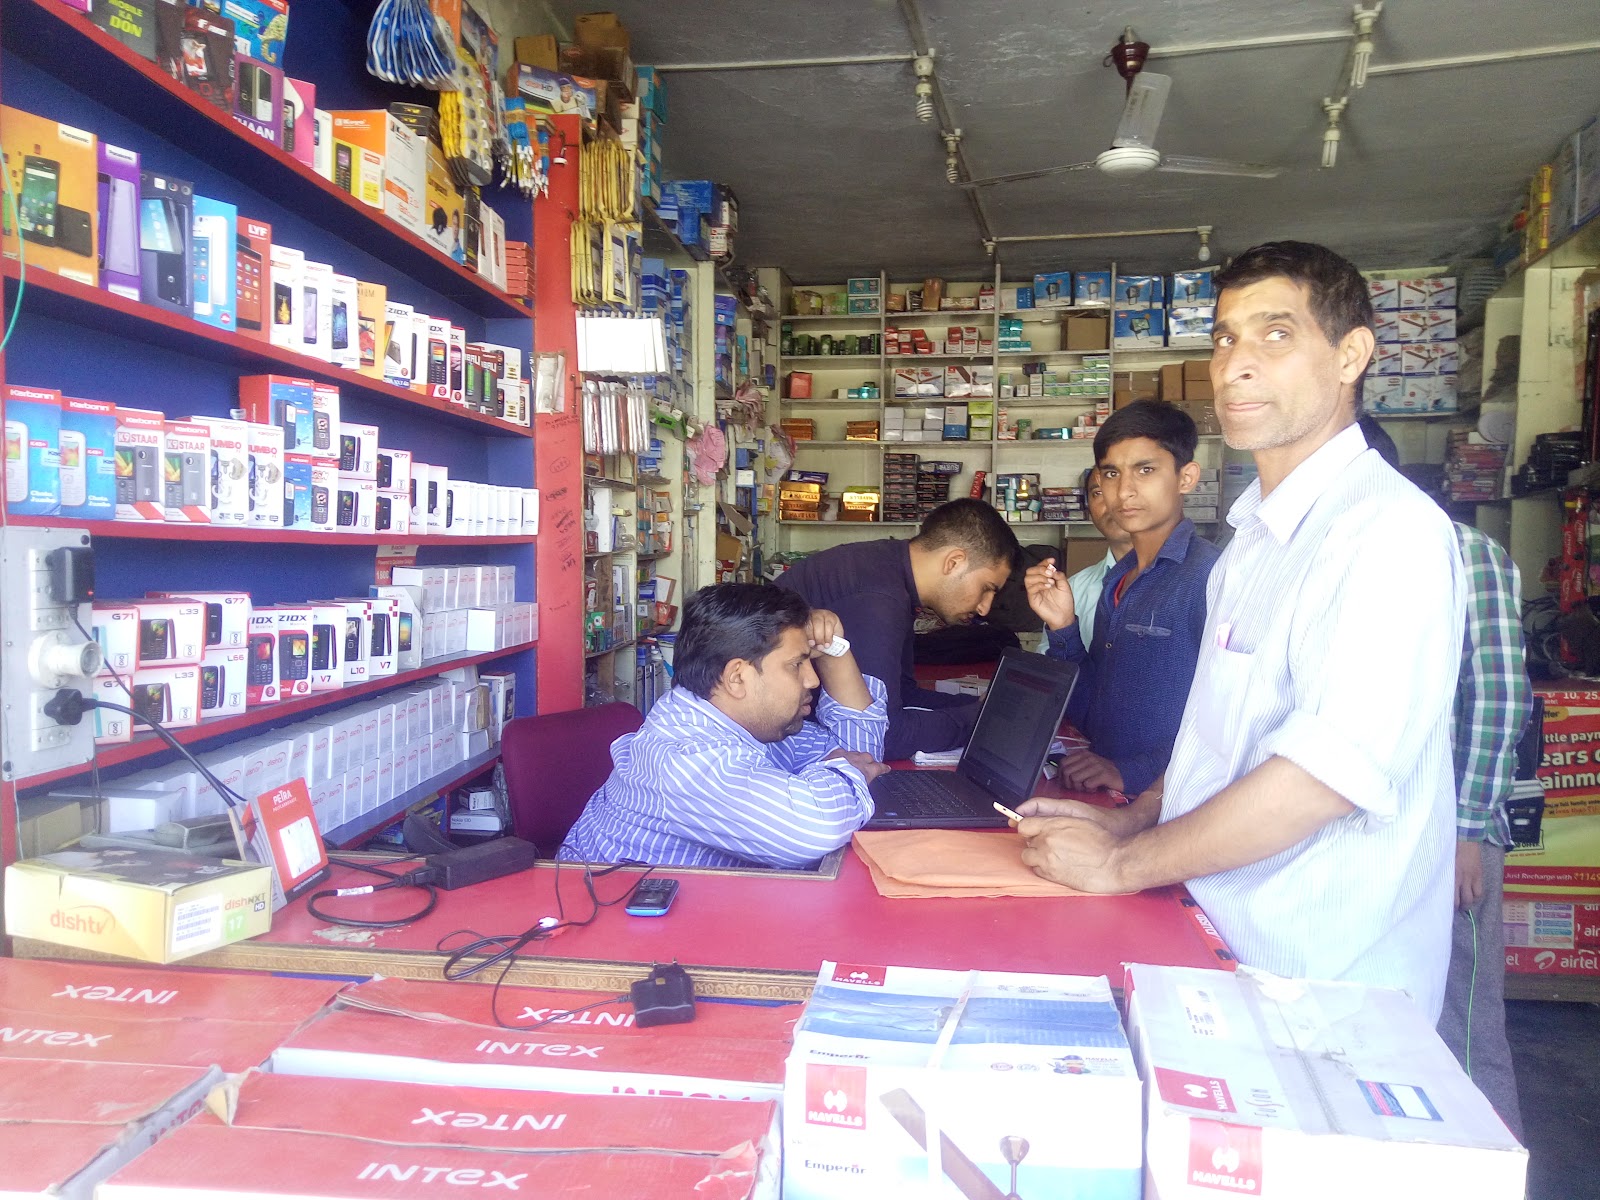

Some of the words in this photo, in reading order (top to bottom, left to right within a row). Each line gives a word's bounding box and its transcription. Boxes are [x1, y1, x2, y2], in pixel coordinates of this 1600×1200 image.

[109, 15, 143, 38] DON
[247, 223, 269, 237] LYF
[10, 388, 54, 400] Karbonn
[69, 401, 110, 412] Karbonn
[130, 433, 159, 445] STAAR
[179, 440, 206, 451] STAAR
[393, 452, 409, 460] G77
[392, 494, 408, 502] G77
[224, 597, 245, 605] G77
[111, 612, 135, 620] G71
[278, 614, 307, 622] ZIOX
[226, 654, 245, 662] L66
[350, 667, 365, 675] L10
[379, 661, 391, 670] V7
[174, 671, 194, 679] L33
[320, 675, 332, 683] V7
[272, 789, 293, 806] PETRA
[1521, 872, 1556, 881] Recharge
[254, 901, 264, 912] HD
[50, 905, 116, 935] dishtv
[228, 915, 244, 930] 17
[1560, 955, 1599, 969] airtel
[834, 976, 882, 986] HAVELLS
[1209, 1080, 1229, 1110] HAVELLS
[808, 1109, 864, 1128] HAVELLS
[1192, 1169, 1256, 1191] HAVELLS
